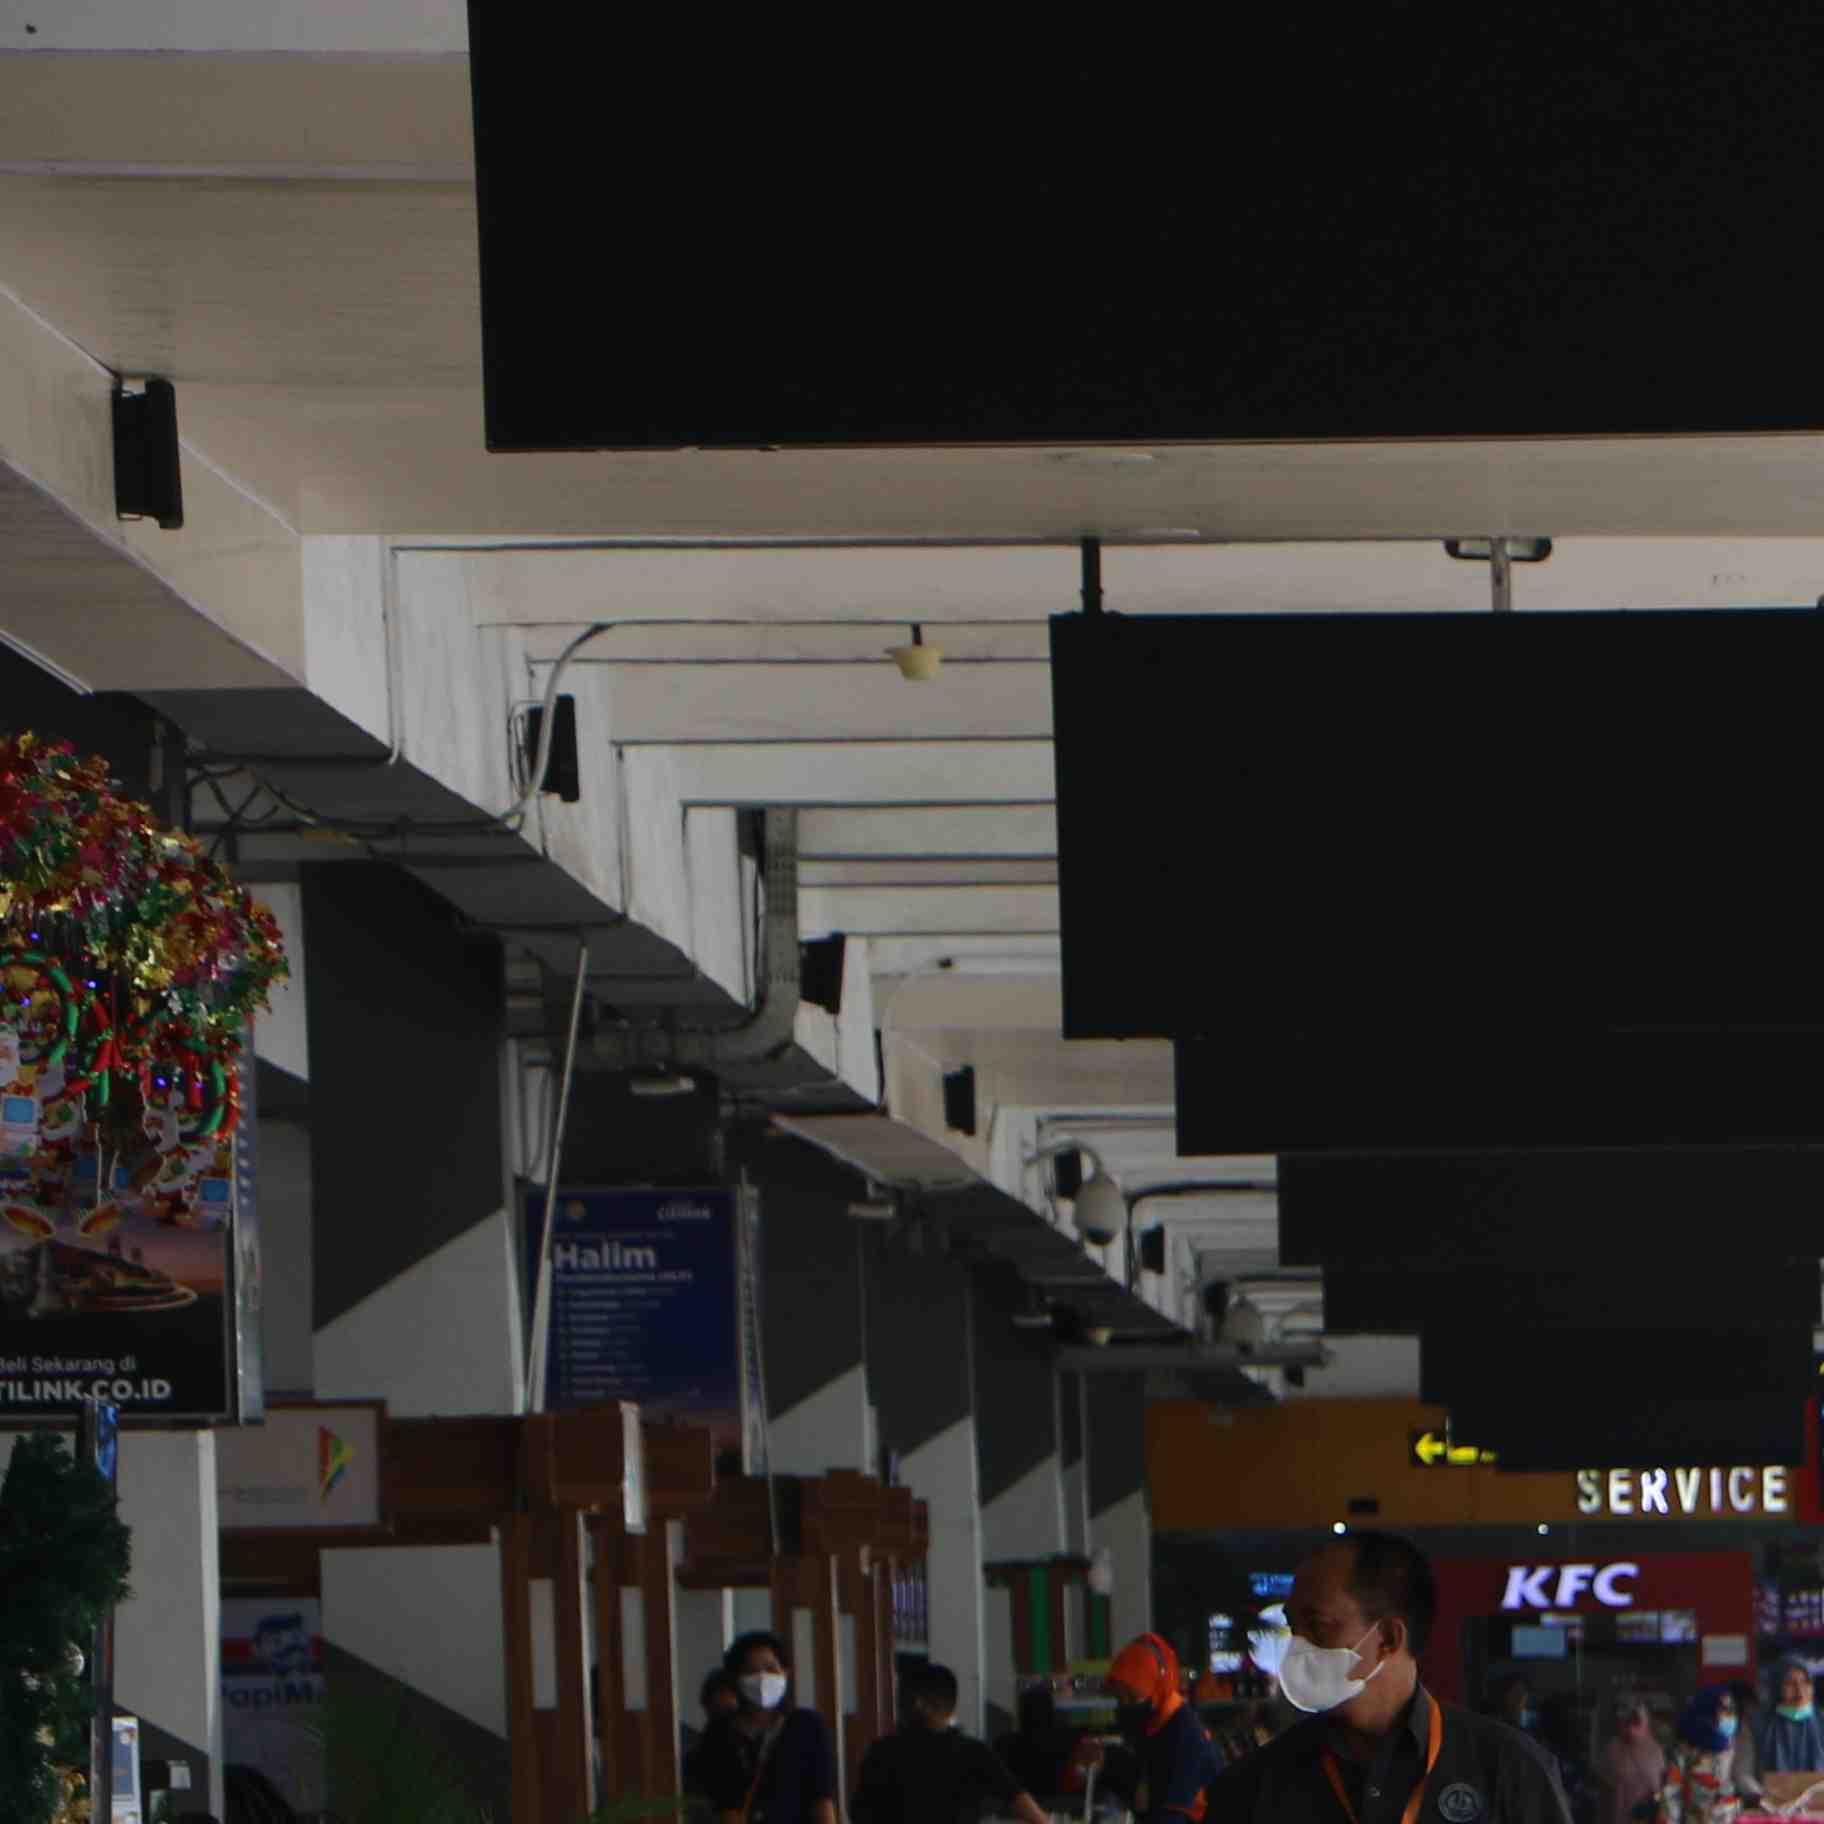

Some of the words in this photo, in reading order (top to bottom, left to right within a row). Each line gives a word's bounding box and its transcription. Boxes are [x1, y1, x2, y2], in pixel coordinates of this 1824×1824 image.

[554, 1240, 657, 1270] Halim
[32, 1355, 115, 1376] Sekarang
[119, 1353, 137, 1372] di
[1577, 1466, 1787, 1514] SERVICE
[1502, 1562, 1640, 1610] KFC
